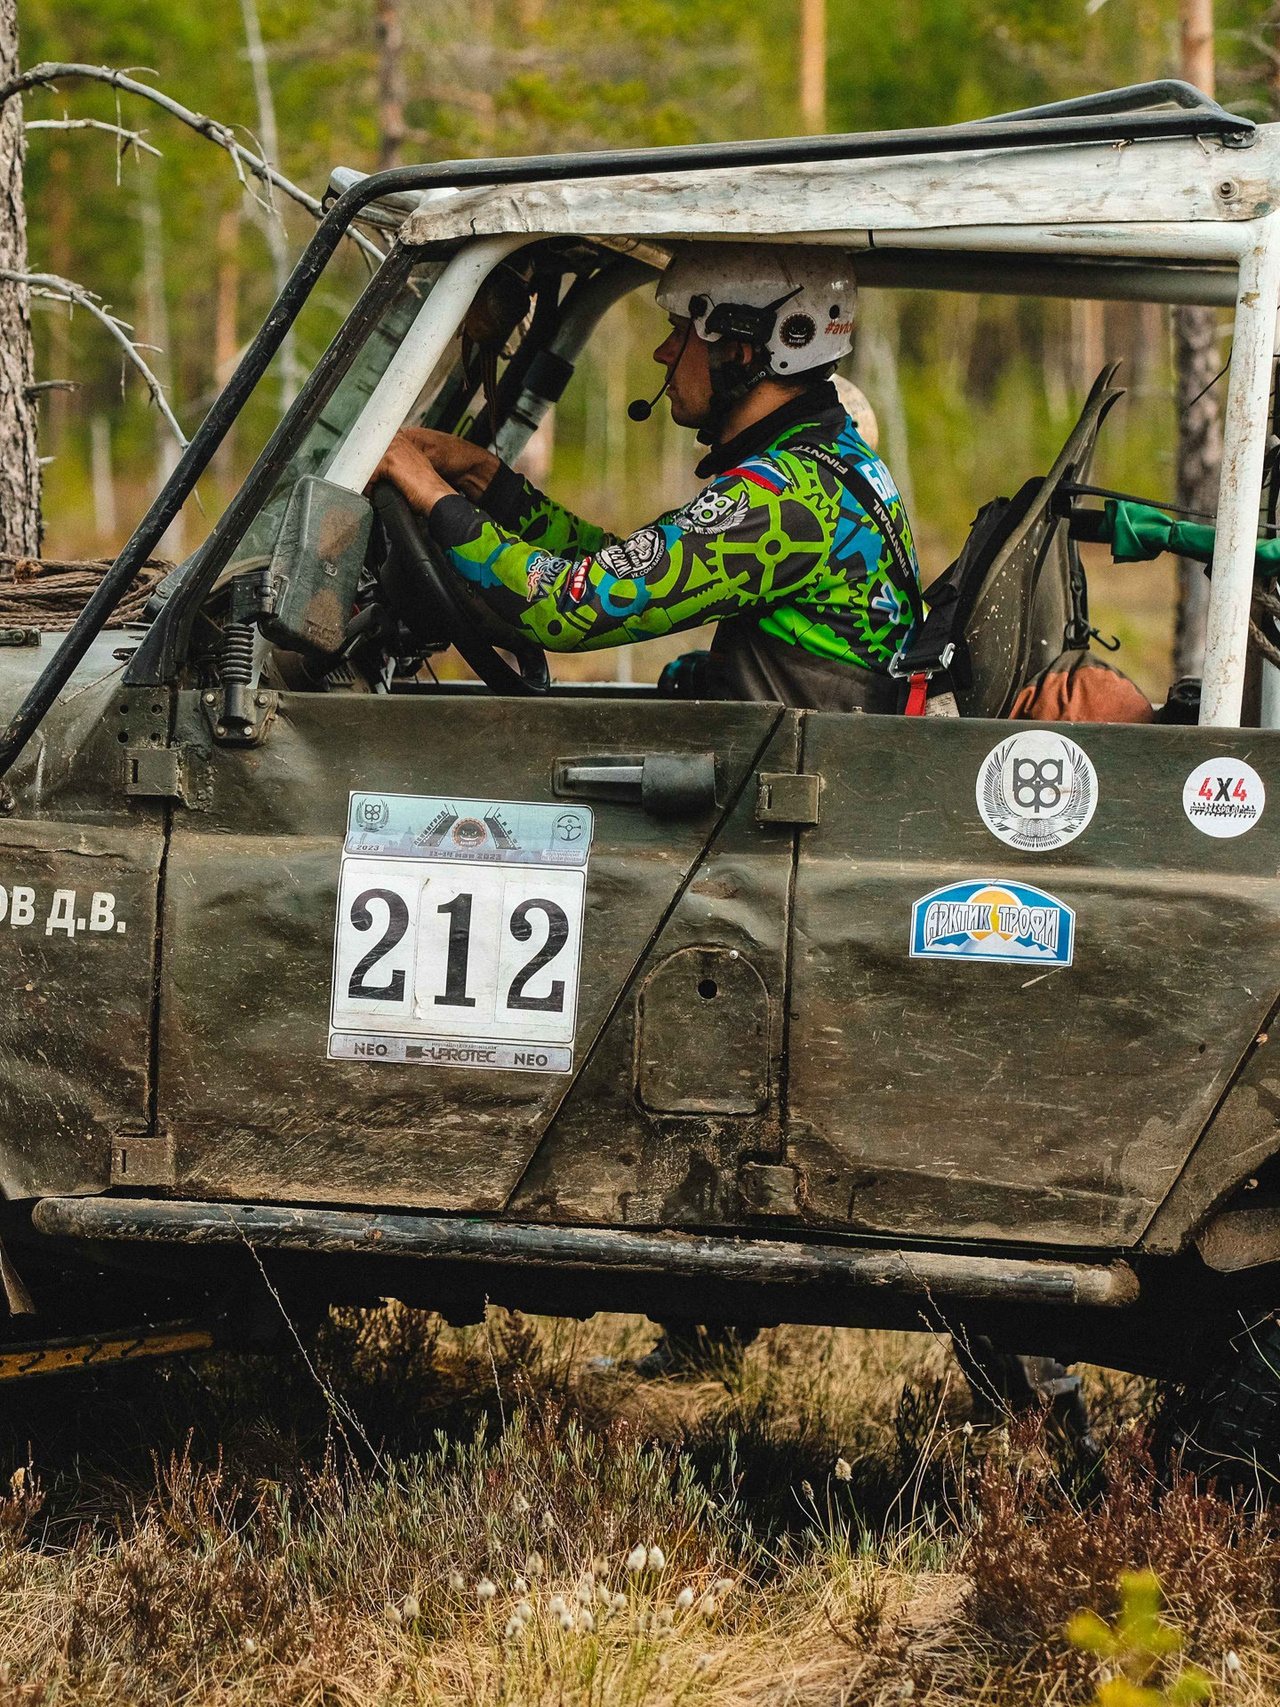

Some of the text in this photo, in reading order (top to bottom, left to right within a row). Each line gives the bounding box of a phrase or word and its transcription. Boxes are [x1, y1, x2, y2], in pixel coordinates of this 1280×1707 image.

[873, 498, 910, 578] FINNTRAIL
[477, 852, 502, 861] 2023
[46, 888, 126, 937] Д.В.
[925, 902, 1058, 949] АРКТИК ТРОФИ
[347, 888, 570, 1013] 212
[354, 1042, 388, 1058] NEO
[421, 1046, 497, 1064] SUPROTEC
[514, 1052, 548, 1067] NEO
